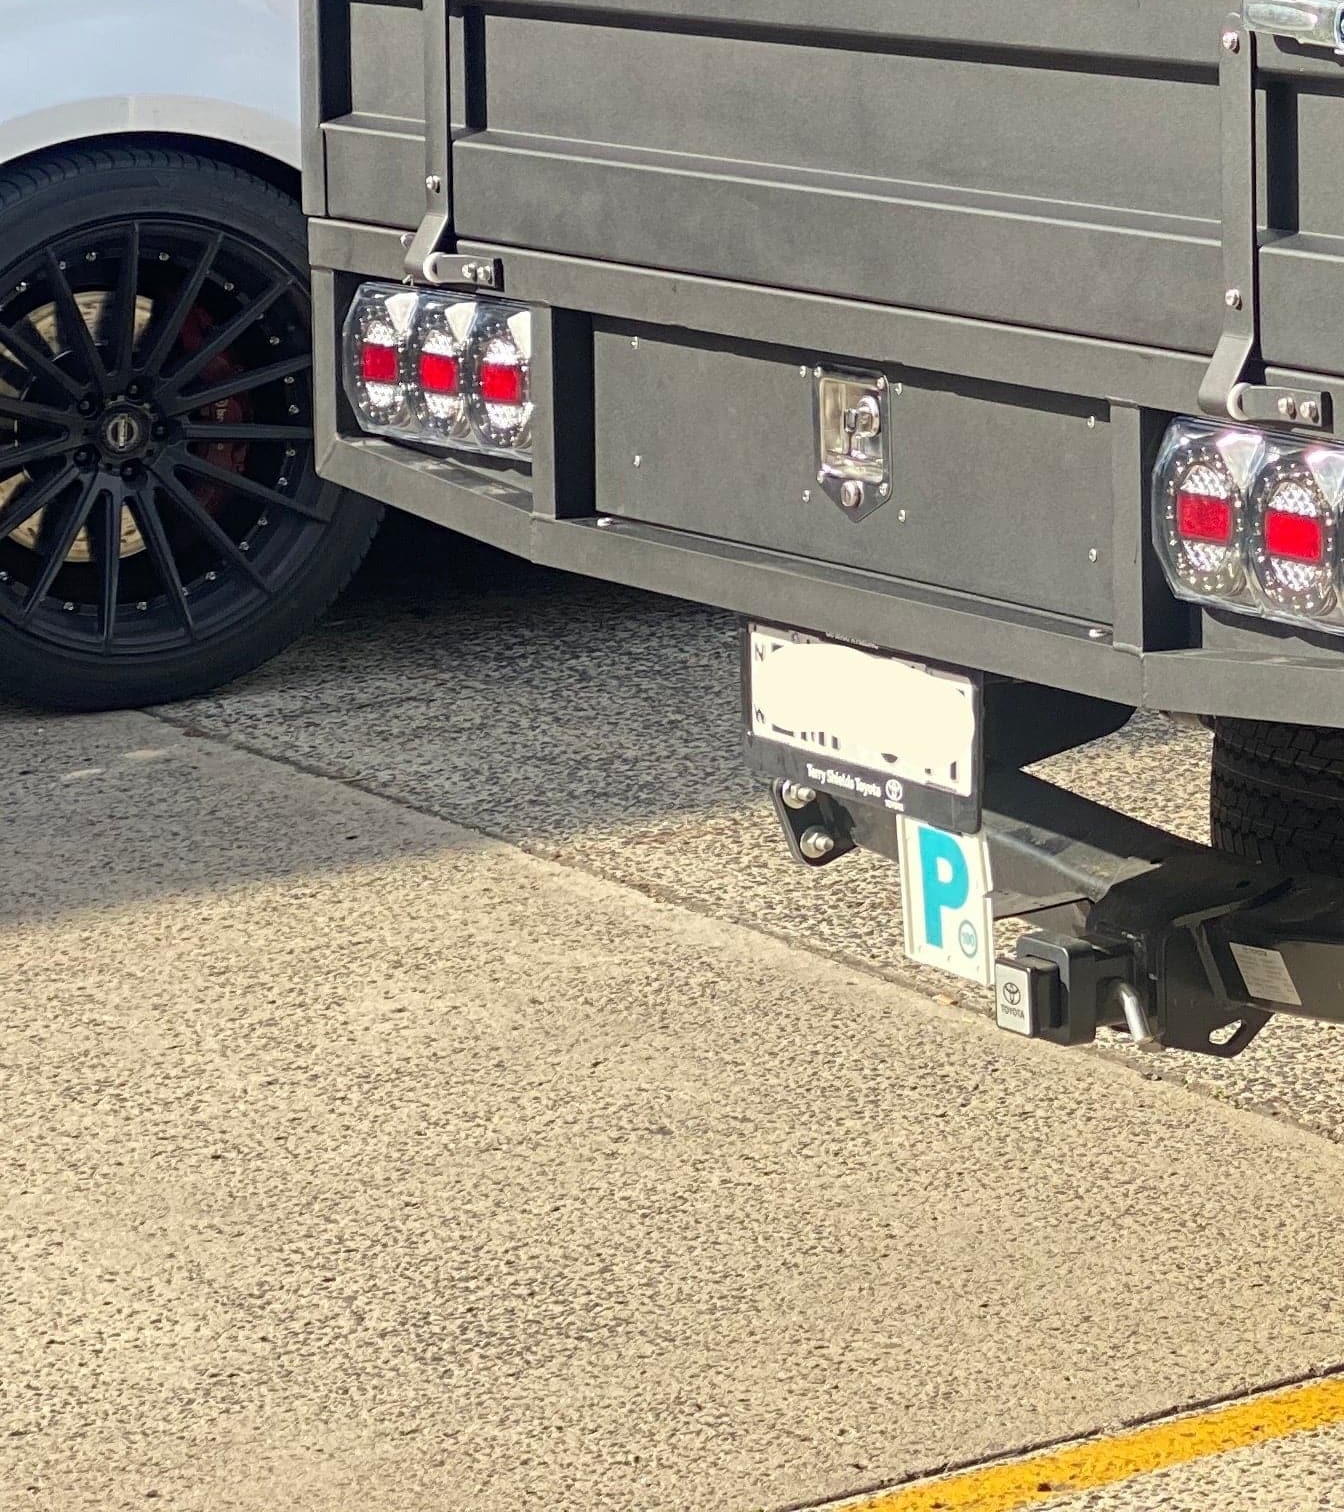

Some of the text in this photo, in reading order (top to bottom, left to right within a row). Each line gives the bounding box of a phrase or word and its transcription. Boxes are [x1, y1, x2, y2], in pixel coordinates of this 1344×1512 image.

[806, 763, 826, 784] Terry
[855, 776, 882, 798] Toyota
[918, 825, 969, 949] P
